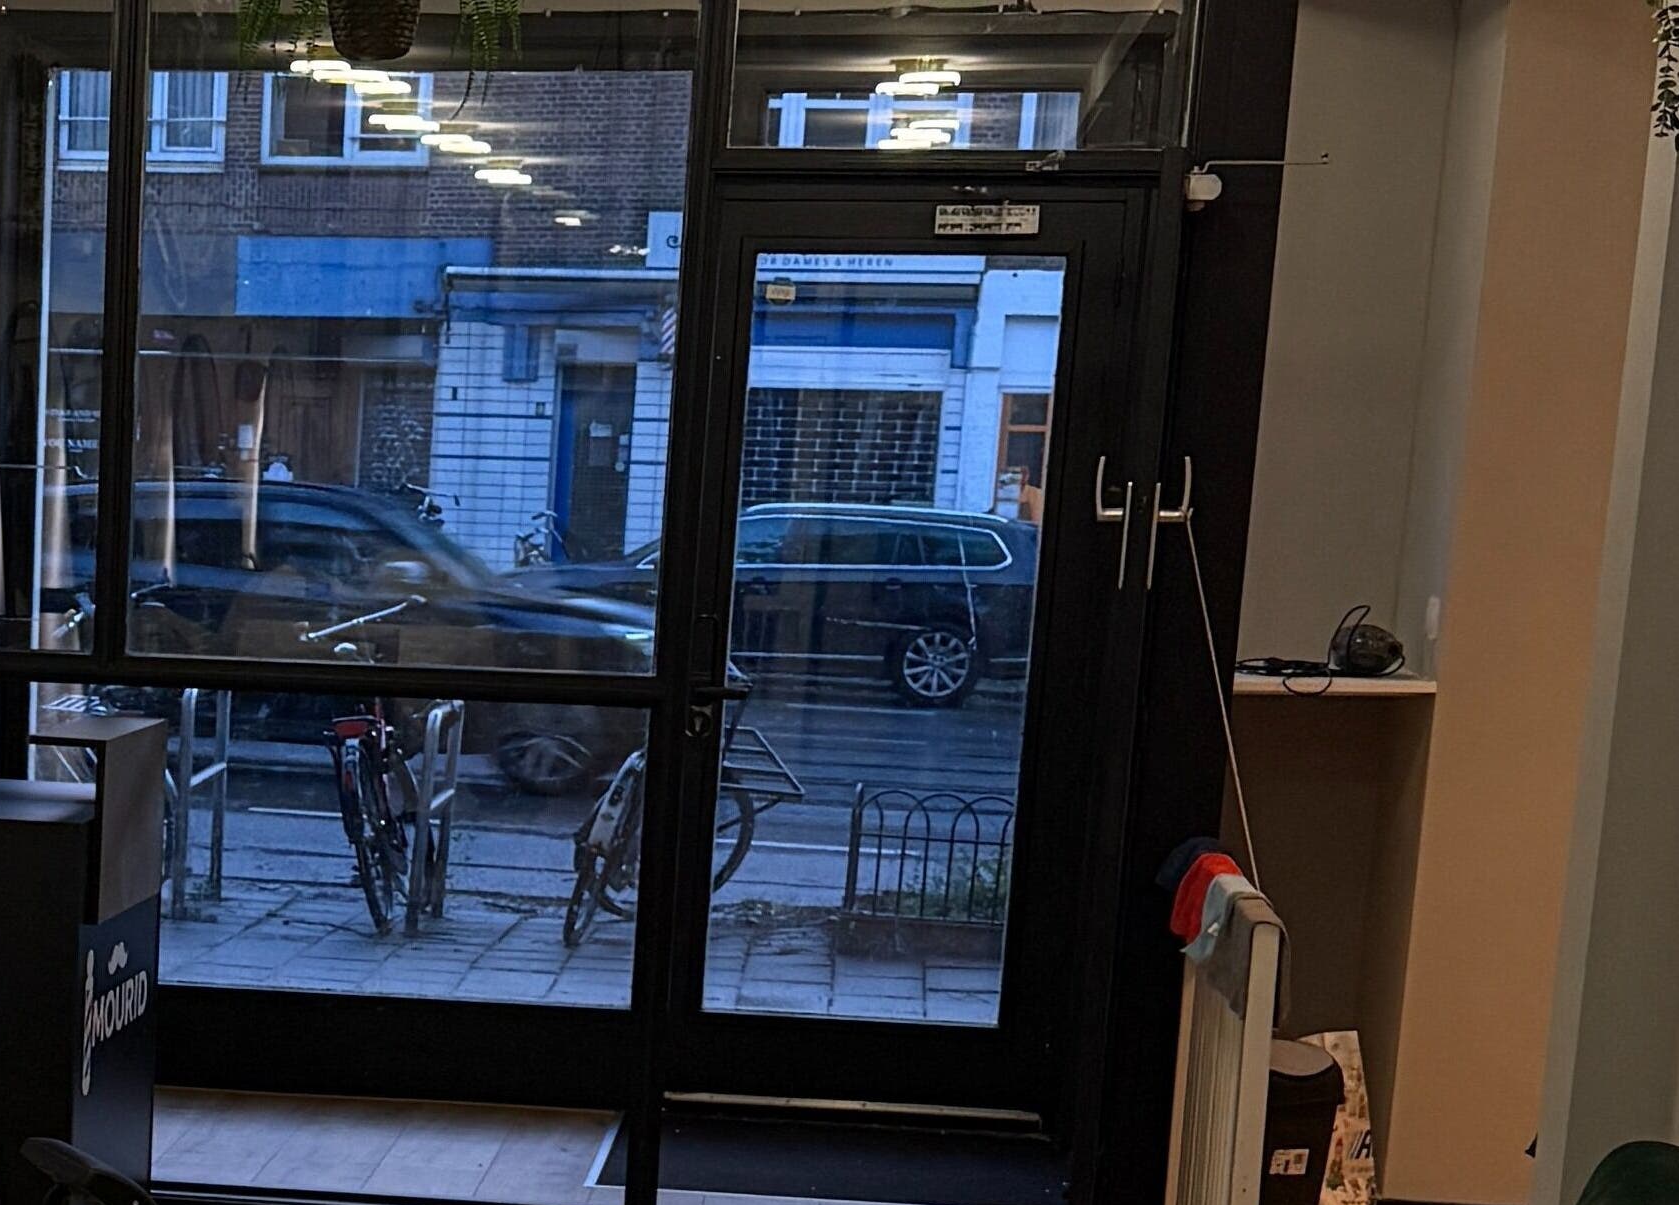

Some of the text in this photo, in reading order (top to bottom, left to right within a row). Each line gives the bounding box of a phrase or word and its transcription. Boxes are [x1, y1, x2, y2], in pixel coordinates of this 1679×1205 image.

[782, 256, 829, 267] DAMES
[847, 257, 894, 267] HEREN
[91, 969, 148, 1047] MOURID
